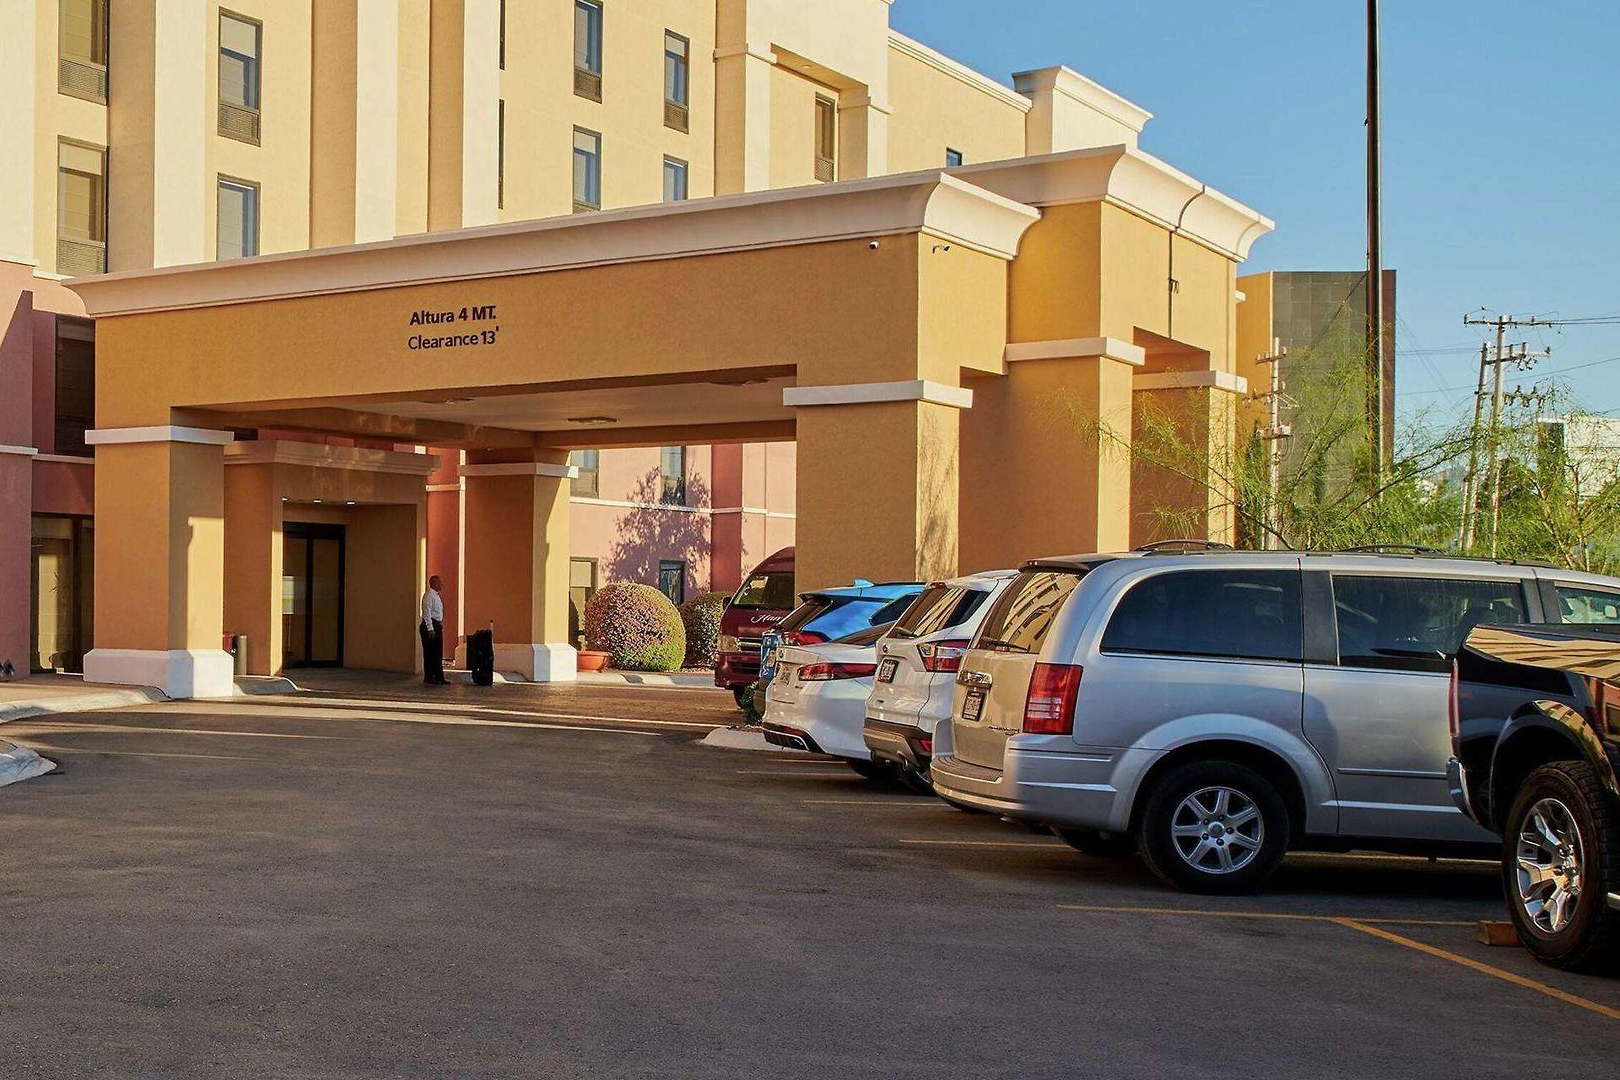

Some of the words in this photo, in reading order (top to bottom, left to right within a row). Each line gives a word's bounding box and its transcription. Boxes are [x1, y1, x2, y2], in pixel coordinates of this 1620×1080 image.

[409, 310, 455, 326] Altura
[458, 307, 468, 321] 4
[472, 305, 497, 321] MT.
[408, 334, 479, 350] Clearance
